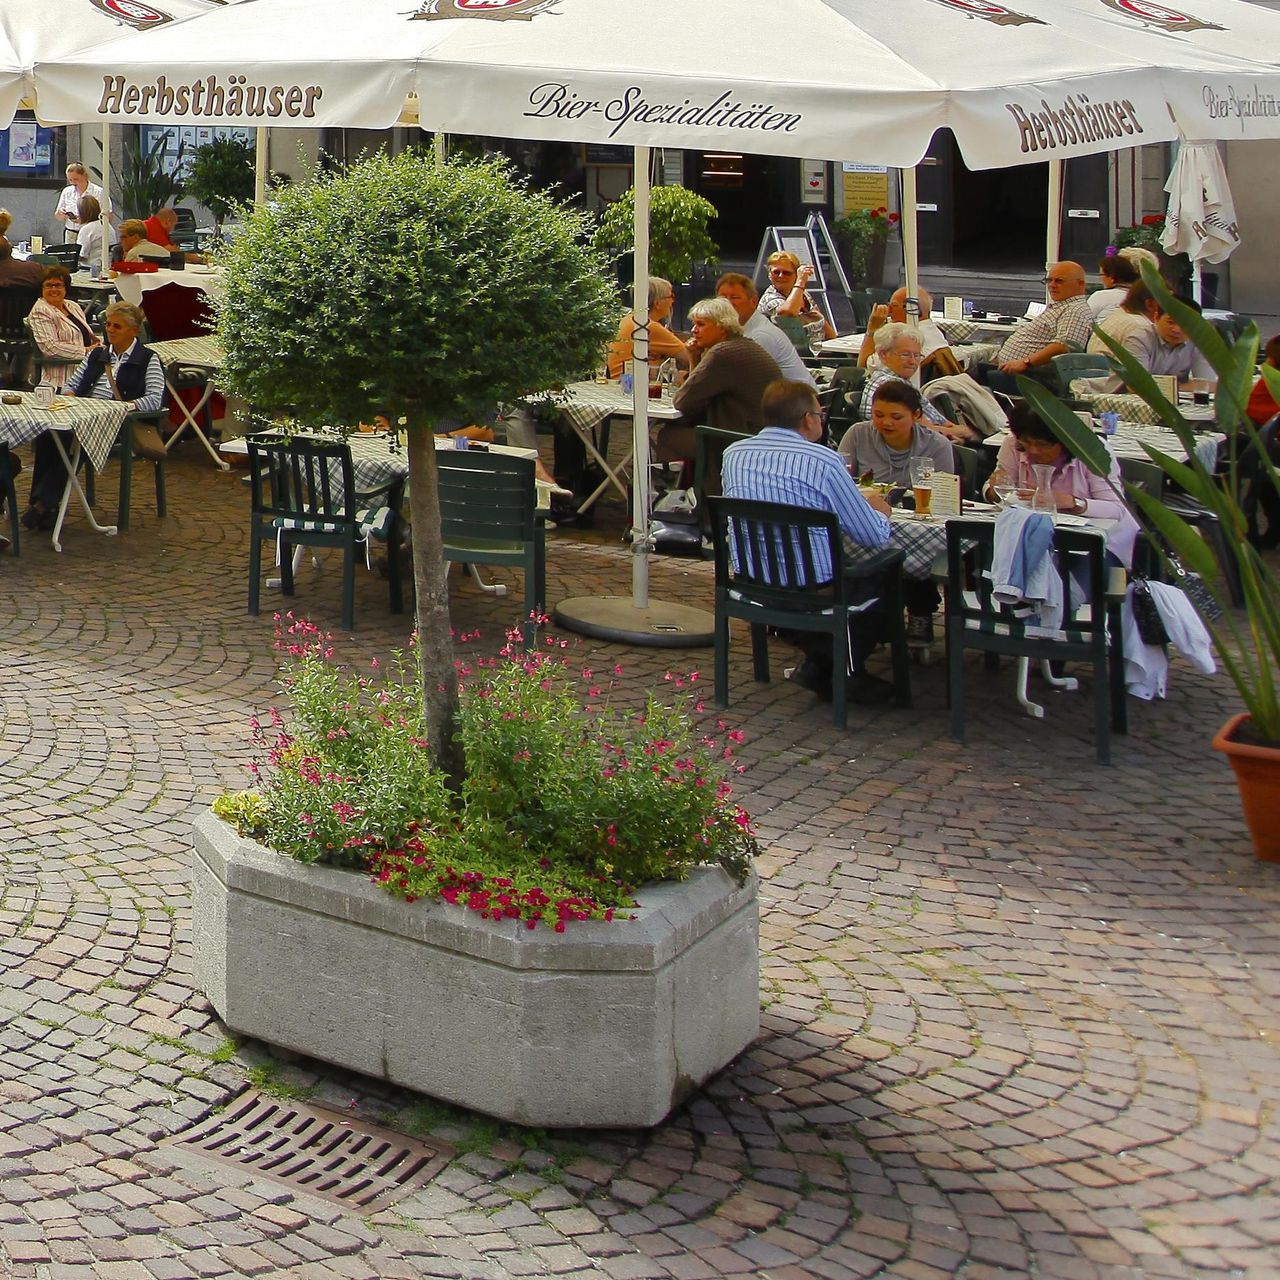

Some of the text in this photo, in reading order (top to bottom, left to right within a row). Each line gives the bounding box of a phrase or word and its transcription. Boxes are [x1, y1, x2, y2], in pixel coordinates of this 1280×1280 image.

[97, 75, 323, 118] Herbsthäuser
[522, 82, 804, 139] Bier-Spezialitäten
[1005, 93, 1145, 153] Herbsthäuser
